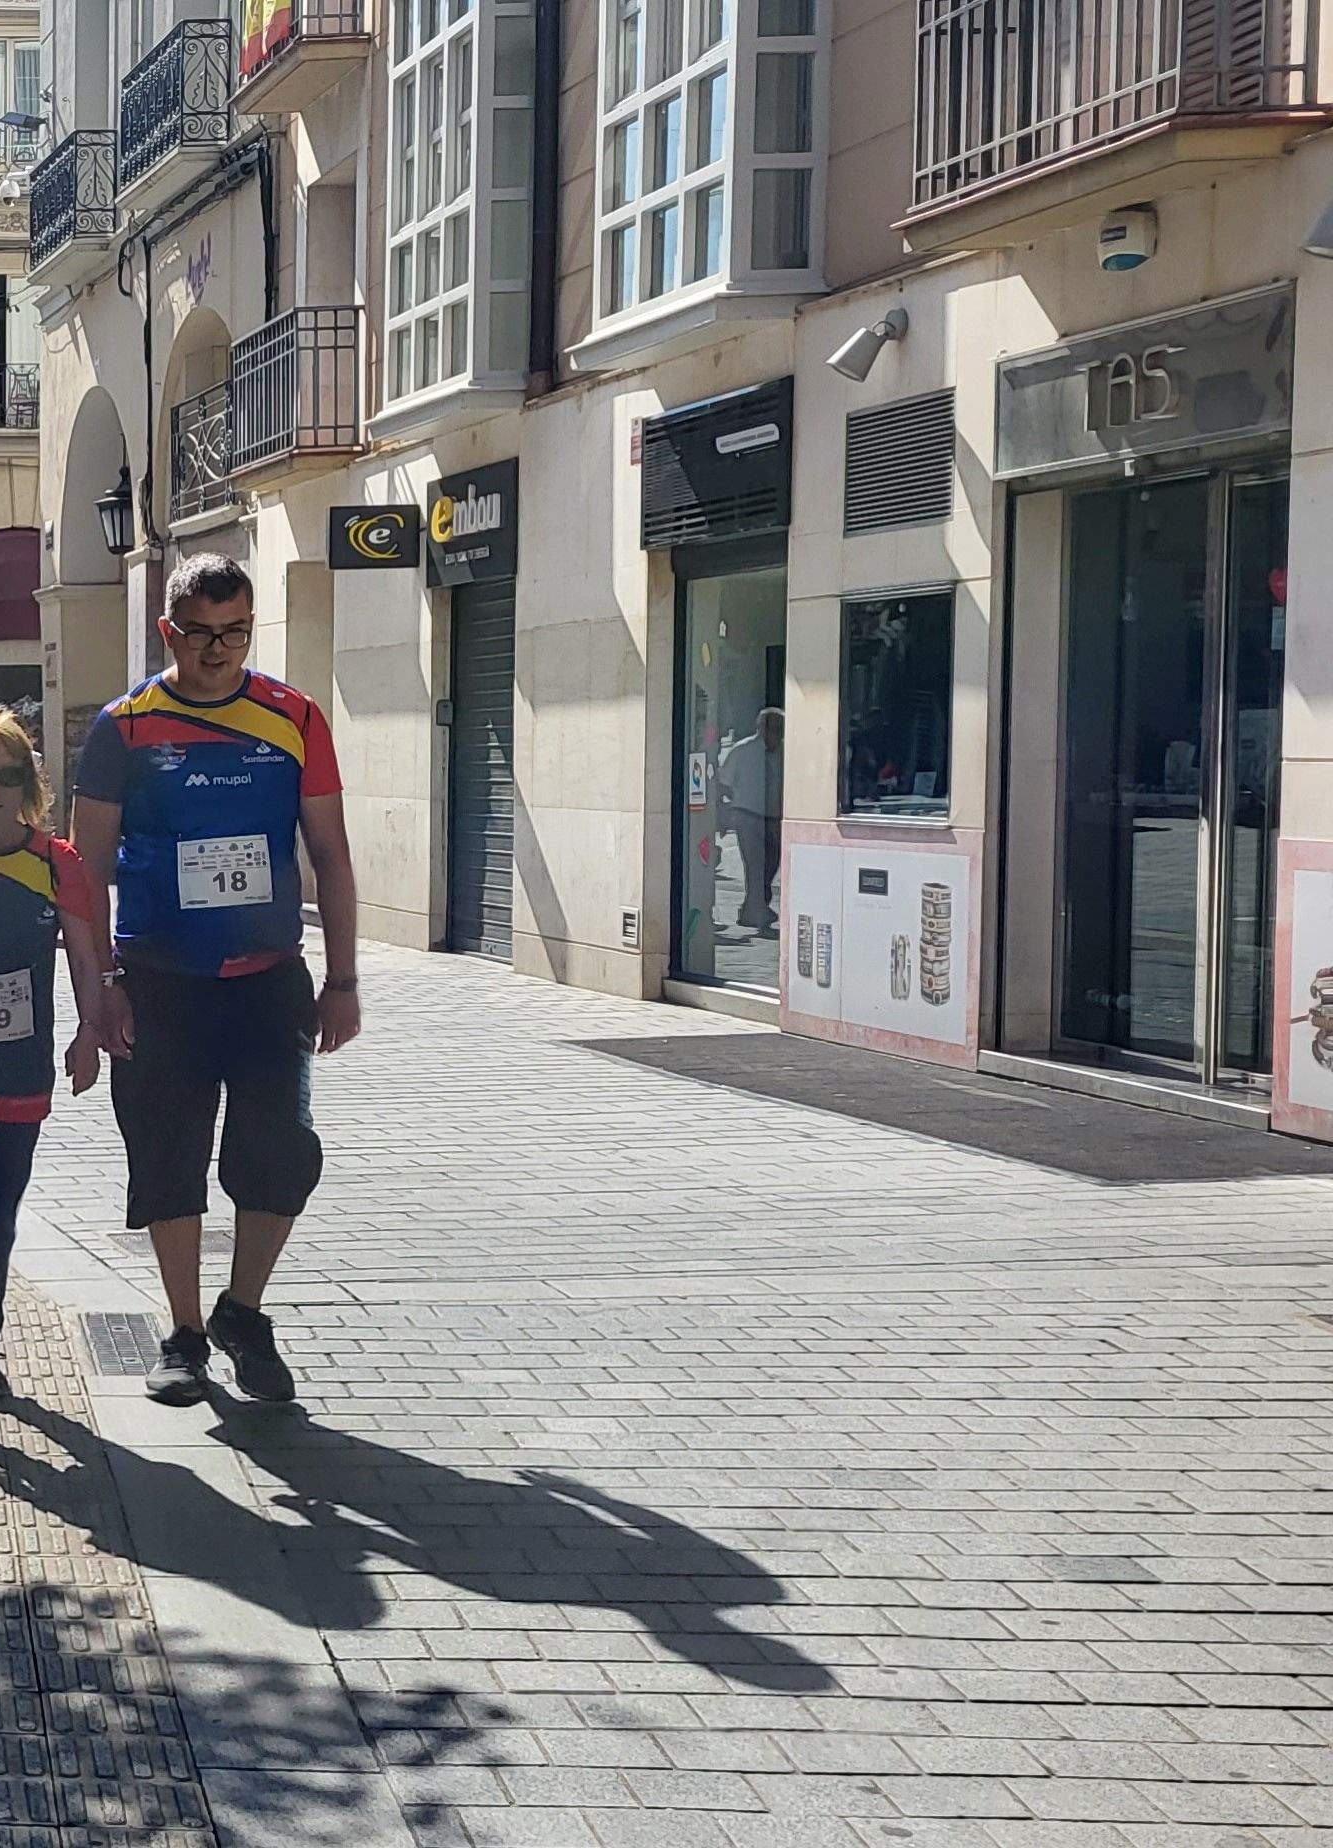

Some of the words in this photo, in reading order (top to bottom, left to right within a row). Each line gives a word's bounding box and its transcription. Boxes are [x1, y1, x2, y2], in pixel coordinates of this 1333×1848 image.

[241, 755, 285, 763] Santander
[212, 772, 252, 787] mupol
[212, 871, 248, 893] 18
